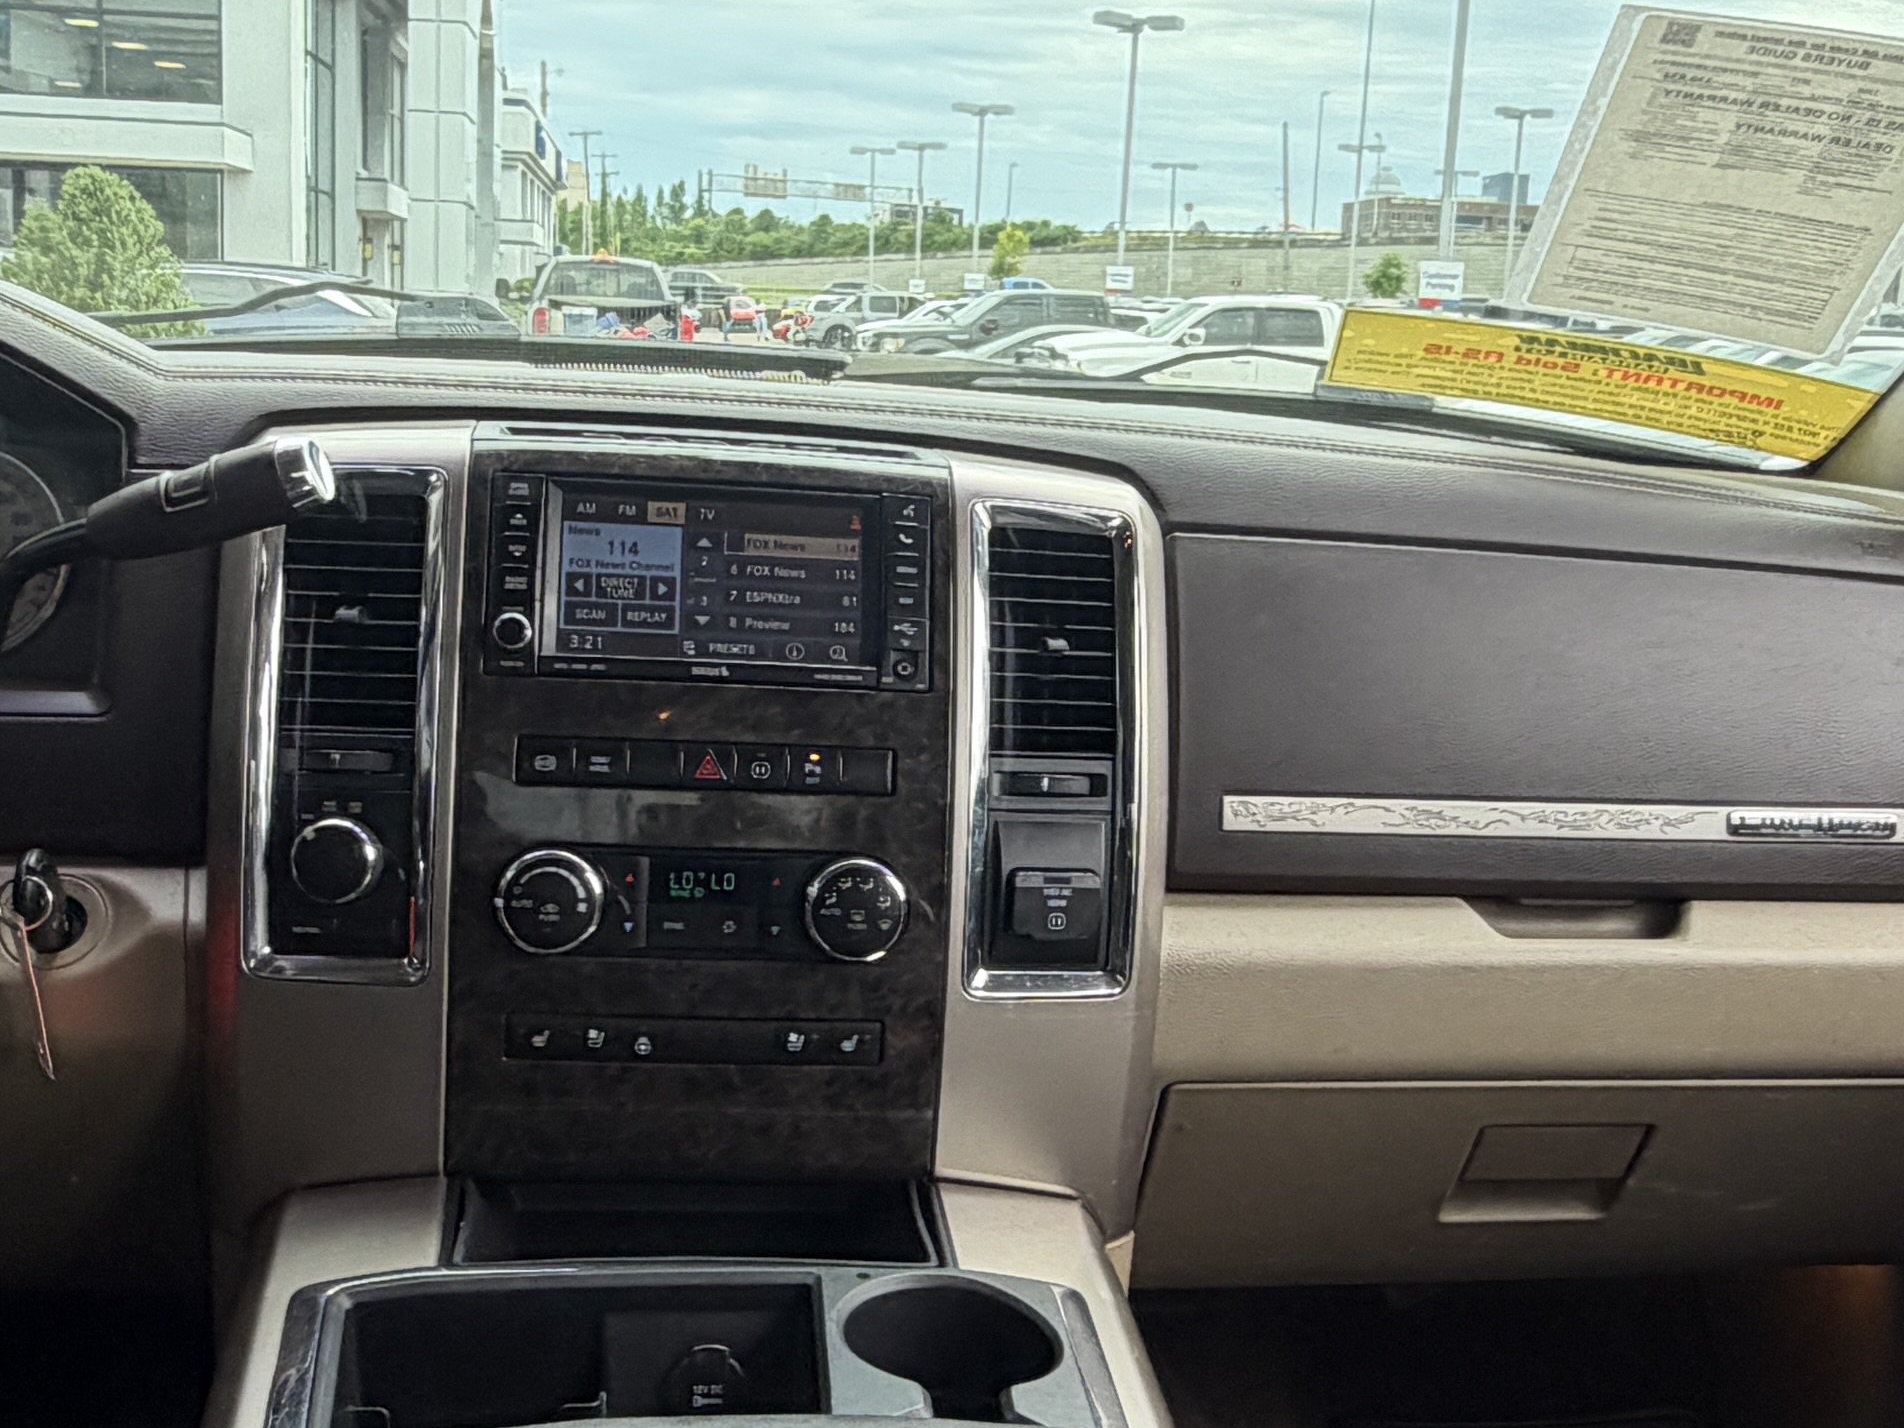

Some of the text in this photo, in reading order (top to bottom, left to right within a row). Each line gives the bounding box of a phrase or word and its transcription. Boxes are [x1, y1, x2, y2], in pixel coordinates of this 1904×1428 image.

[576, 502, 596, 514] AM
[618, 504, 636, 516] FM
[655, 506, 678, 518] SAT
[700, 508, 715, 521] TV
[567, 525, 601, 537] News
[607, 539, 640, 556] 114
[746, 537, 770, 549] FOX
[773, 539, 807, 552] News
[568, 557, 674, 572] FOX News Channel
[746, 565, 771, 577] FOX
[774, 567, 807, 579] News
[834, 569, 856, 581] 114
[600, 577, 639, 588] DIRECT
[606, 587, 635, 599] TUNE
[728, 590, 738, 601] 7
[575, 608, 607, 620] SCAN
[626, 611, 667, 623] REPLAY
[744, 617, 791, 631] Preview
[568, 634, 603, 649] 3:21
[669, 870, 695, 889] LO
[710, 872, 736, 891] LO
